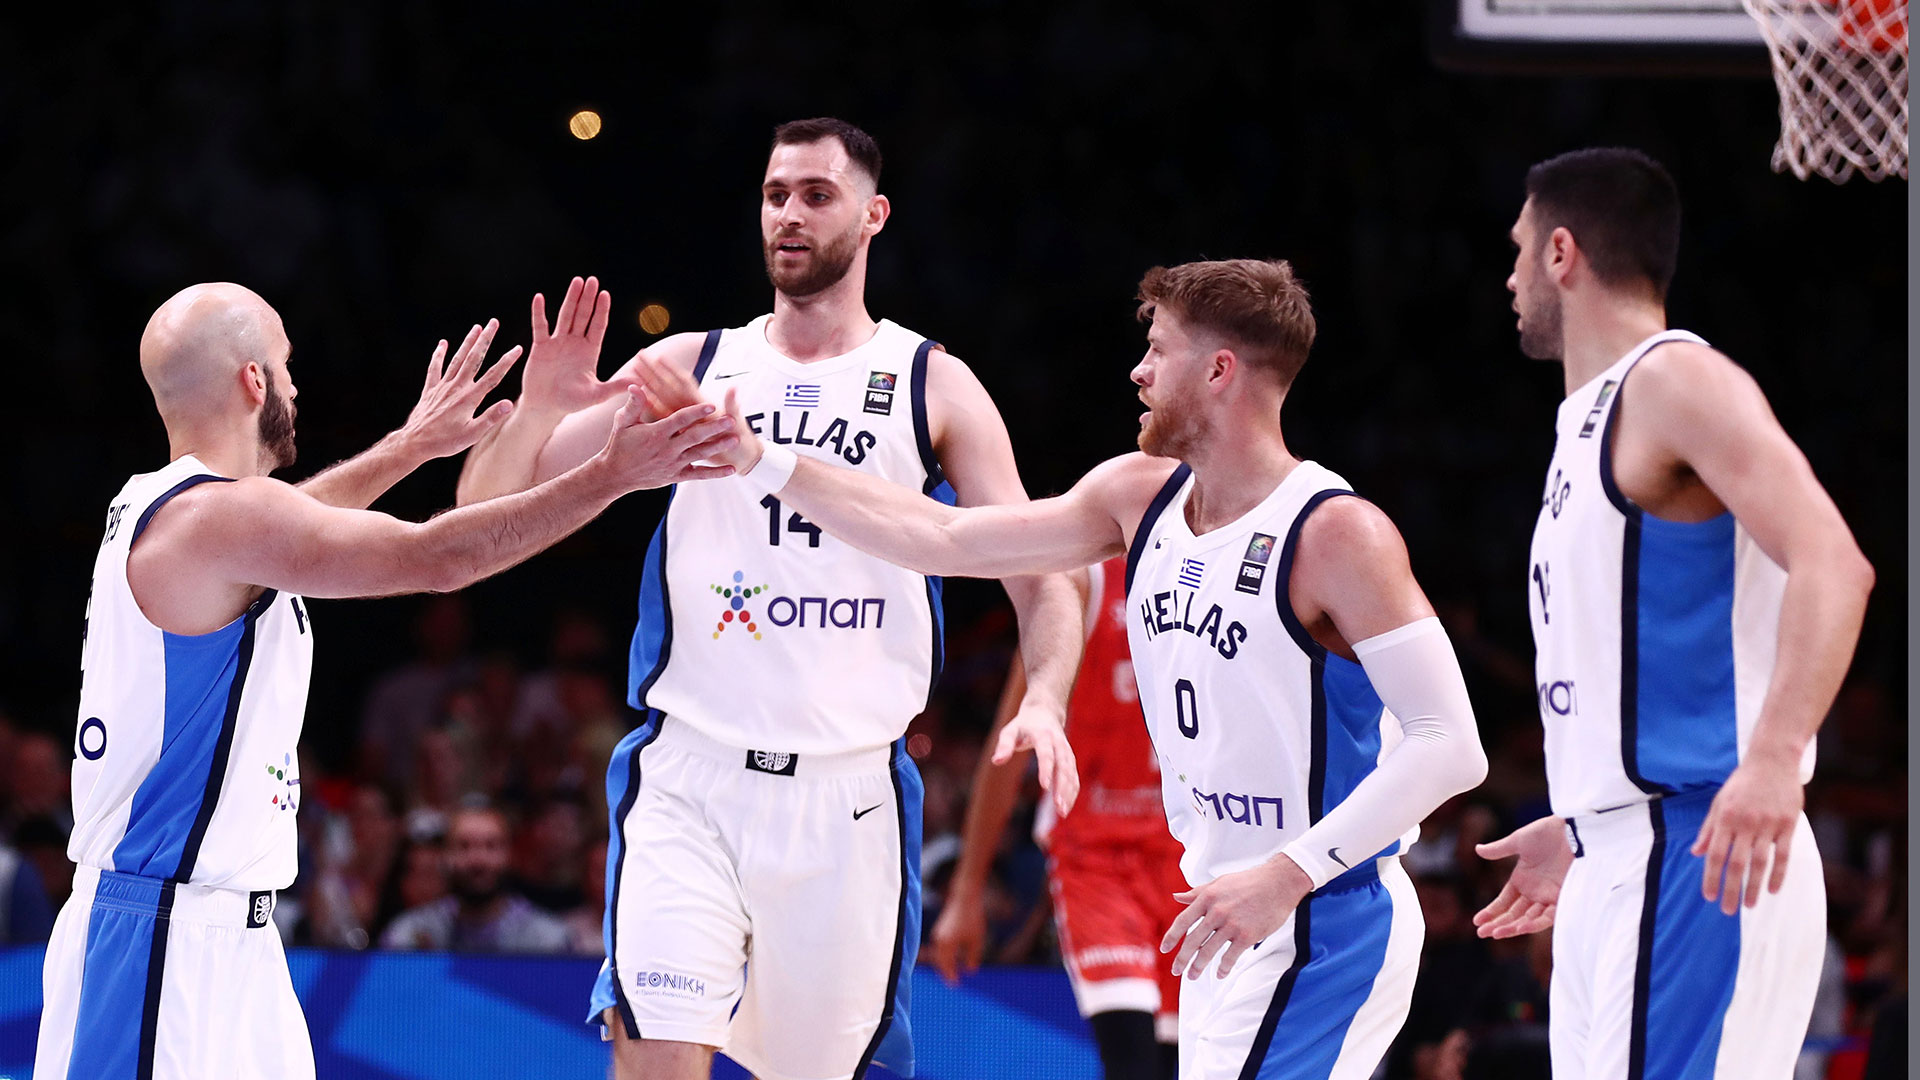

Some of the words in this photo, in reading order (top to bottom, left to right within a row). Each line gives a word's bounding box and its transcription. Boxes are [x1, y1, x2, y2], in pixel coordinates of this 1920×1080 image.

[868, 392, 889, 404] FIBA
[745, 411, 876, 466] ELLAS
[760, 494, 822, 548] 14
[1242, 565, 1262, 579] FIBA
[1141, 590, 1248, 660] HELLAS
[1174, 678, 1199, 740] 0
